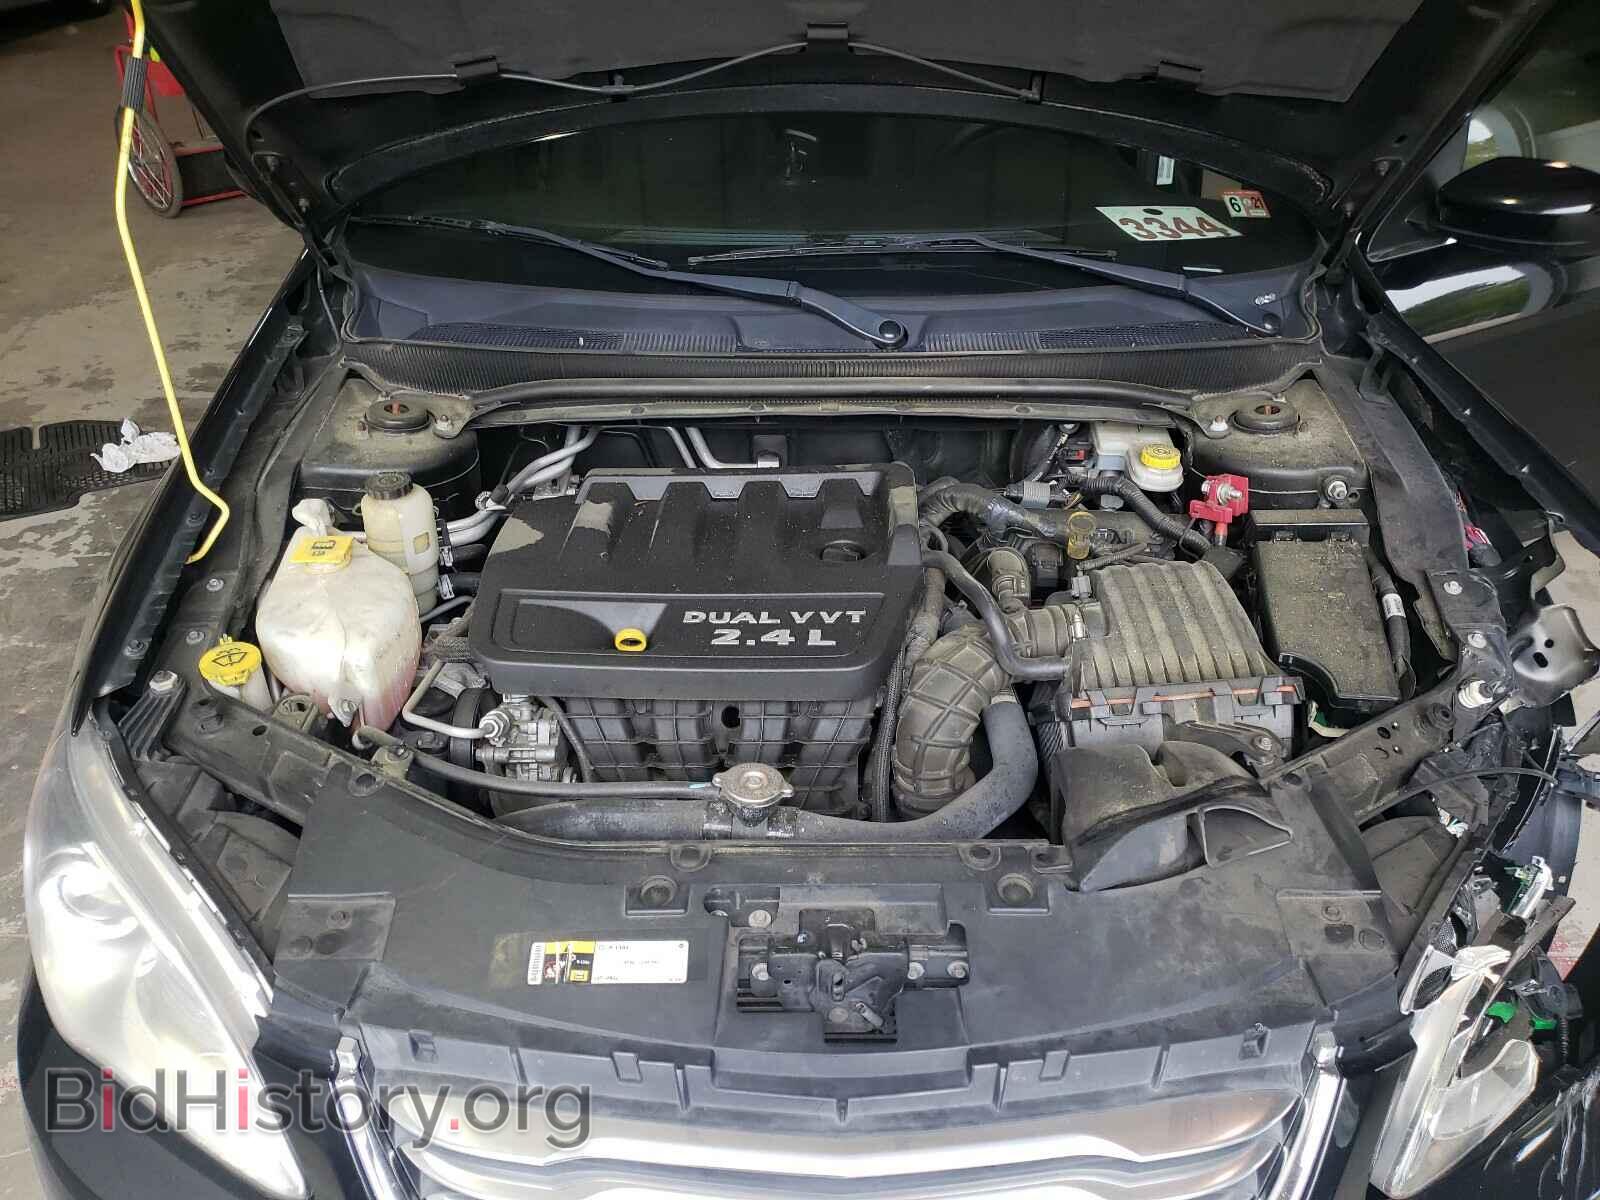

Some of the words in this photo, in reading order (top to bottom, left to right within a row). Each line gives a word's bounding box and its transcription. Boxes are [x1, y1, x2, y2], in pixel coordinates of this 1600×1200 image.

[1229, 197, 1242, 213] 6
[1118, 216, 1233, 240] 3344
[682, 610, 781, 624] DUAL
[790, 609, 867, 624] VVT
